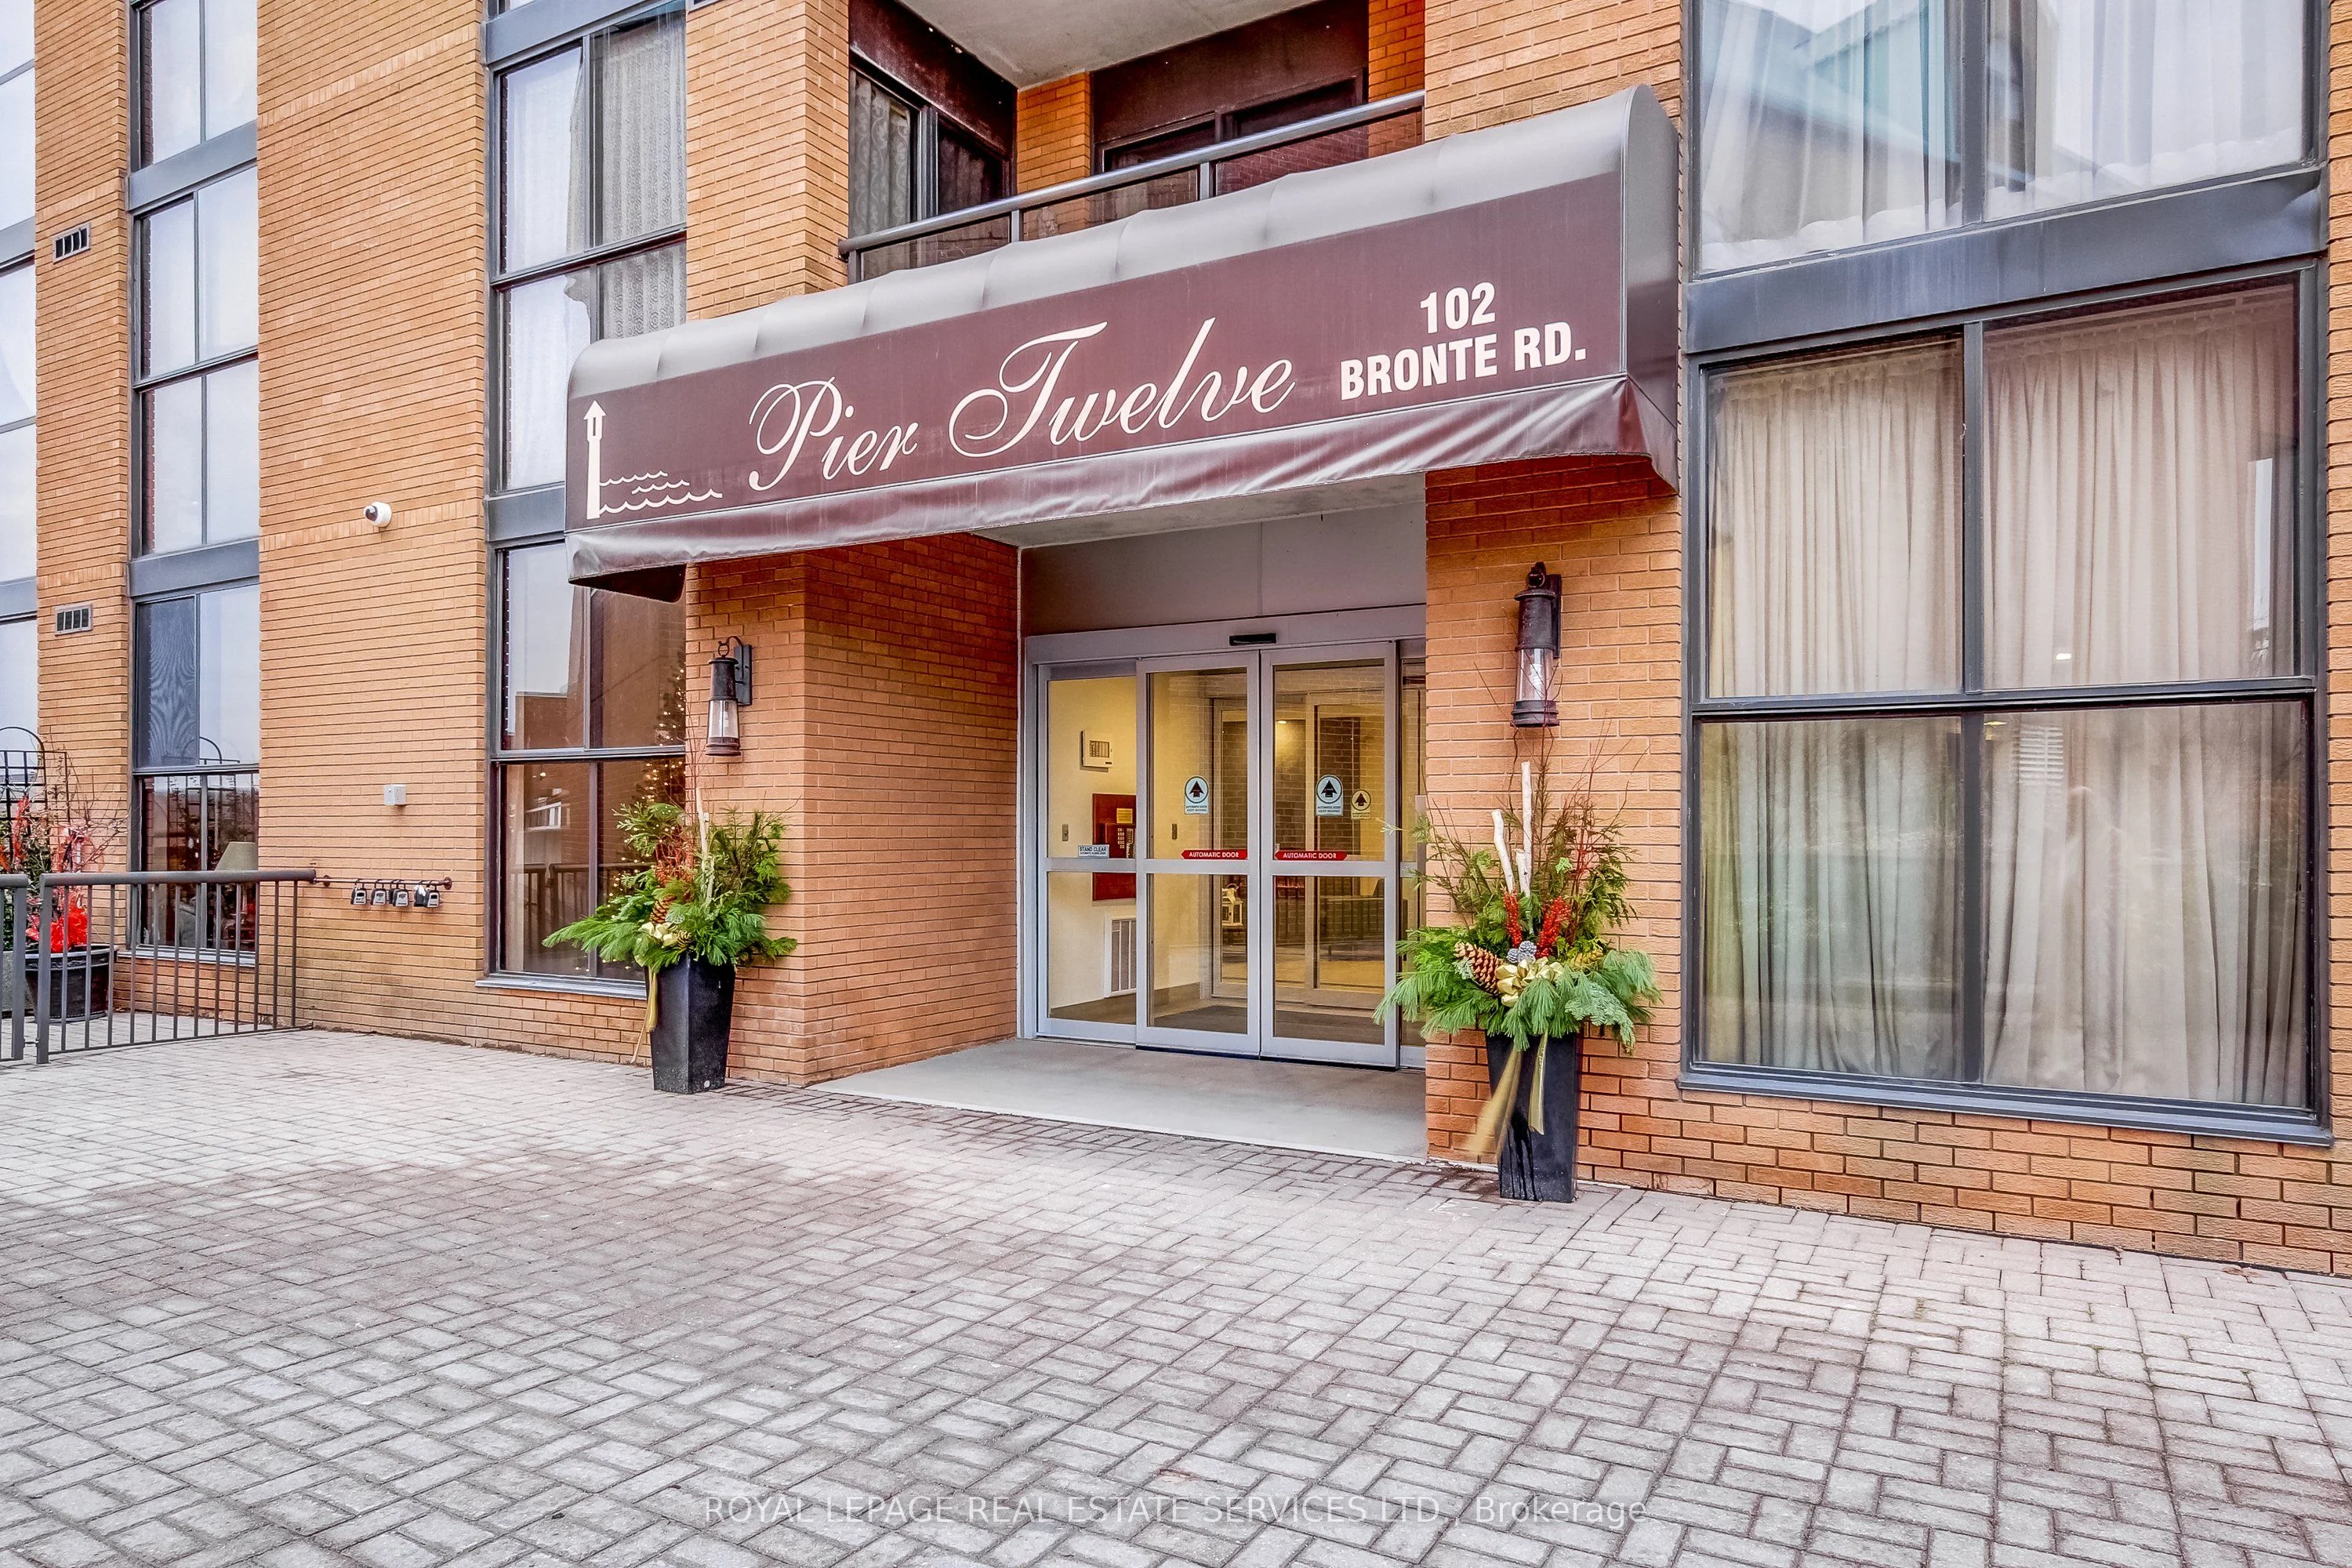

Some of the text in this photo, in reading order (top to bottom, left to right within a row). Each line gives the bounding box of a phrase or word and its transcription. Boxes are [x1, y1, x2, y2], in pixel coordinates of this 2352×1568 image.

[1419, 281, 1497, 334] 102
[1340, 321, 1587, 401] BRONTE RD.
[748, 317, 1296, 492] Pier Twelve
